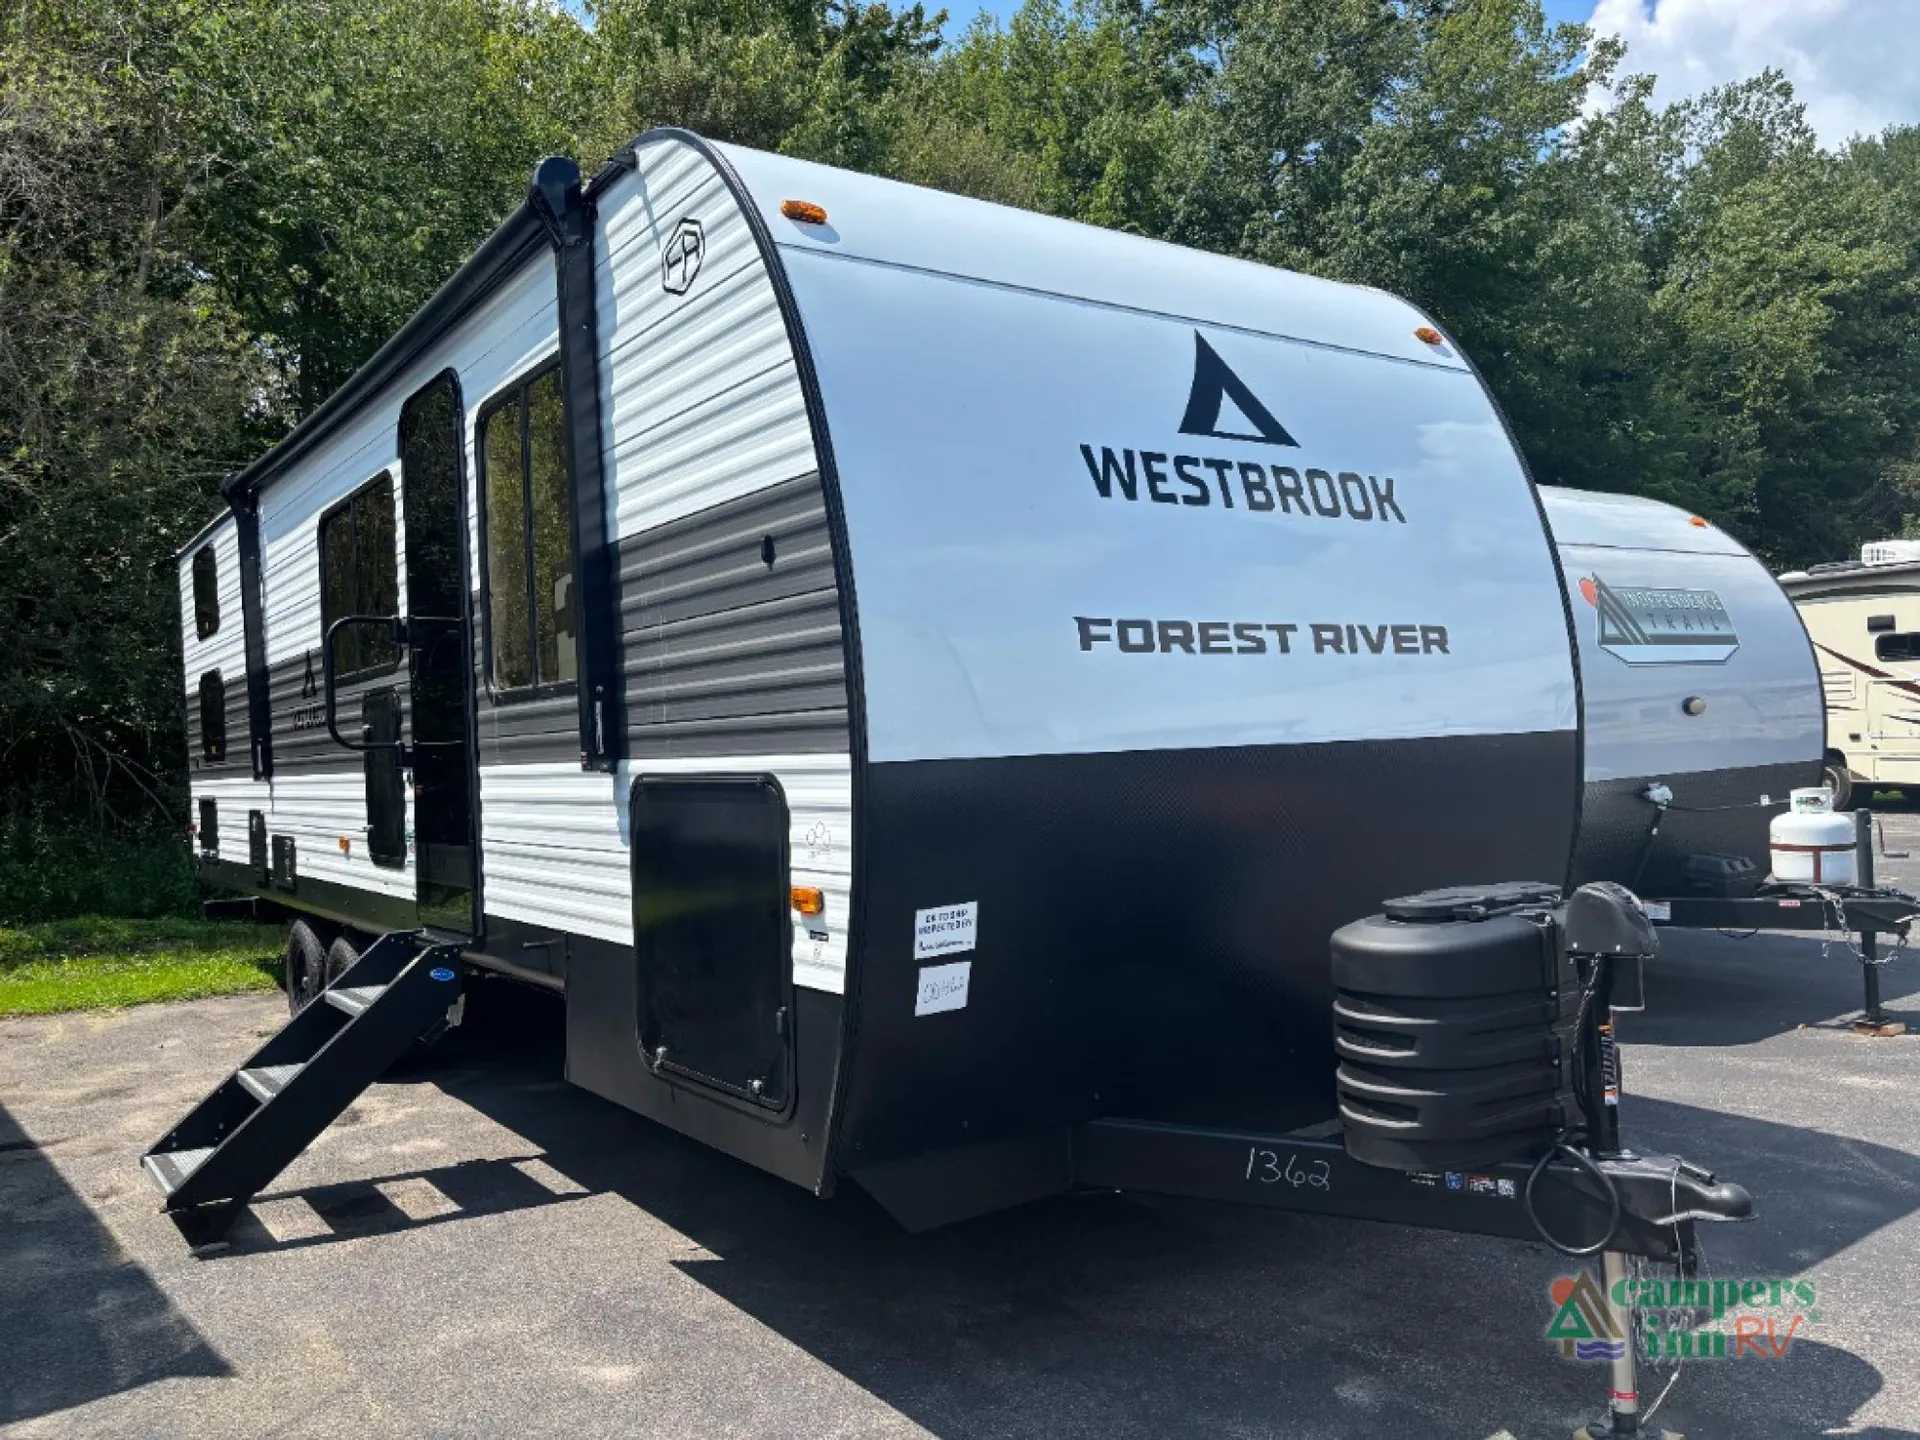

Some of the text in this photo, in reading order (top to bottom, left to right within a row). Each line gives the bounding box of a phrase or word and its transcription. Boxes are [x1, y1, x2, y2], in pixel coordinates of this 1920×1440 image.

[1080, 444, 1406, 523] WESTBROOK
[1072, 616, 1450, 655] FOREST RIVER
[1246, 1148, 1330, 1191] 1362
